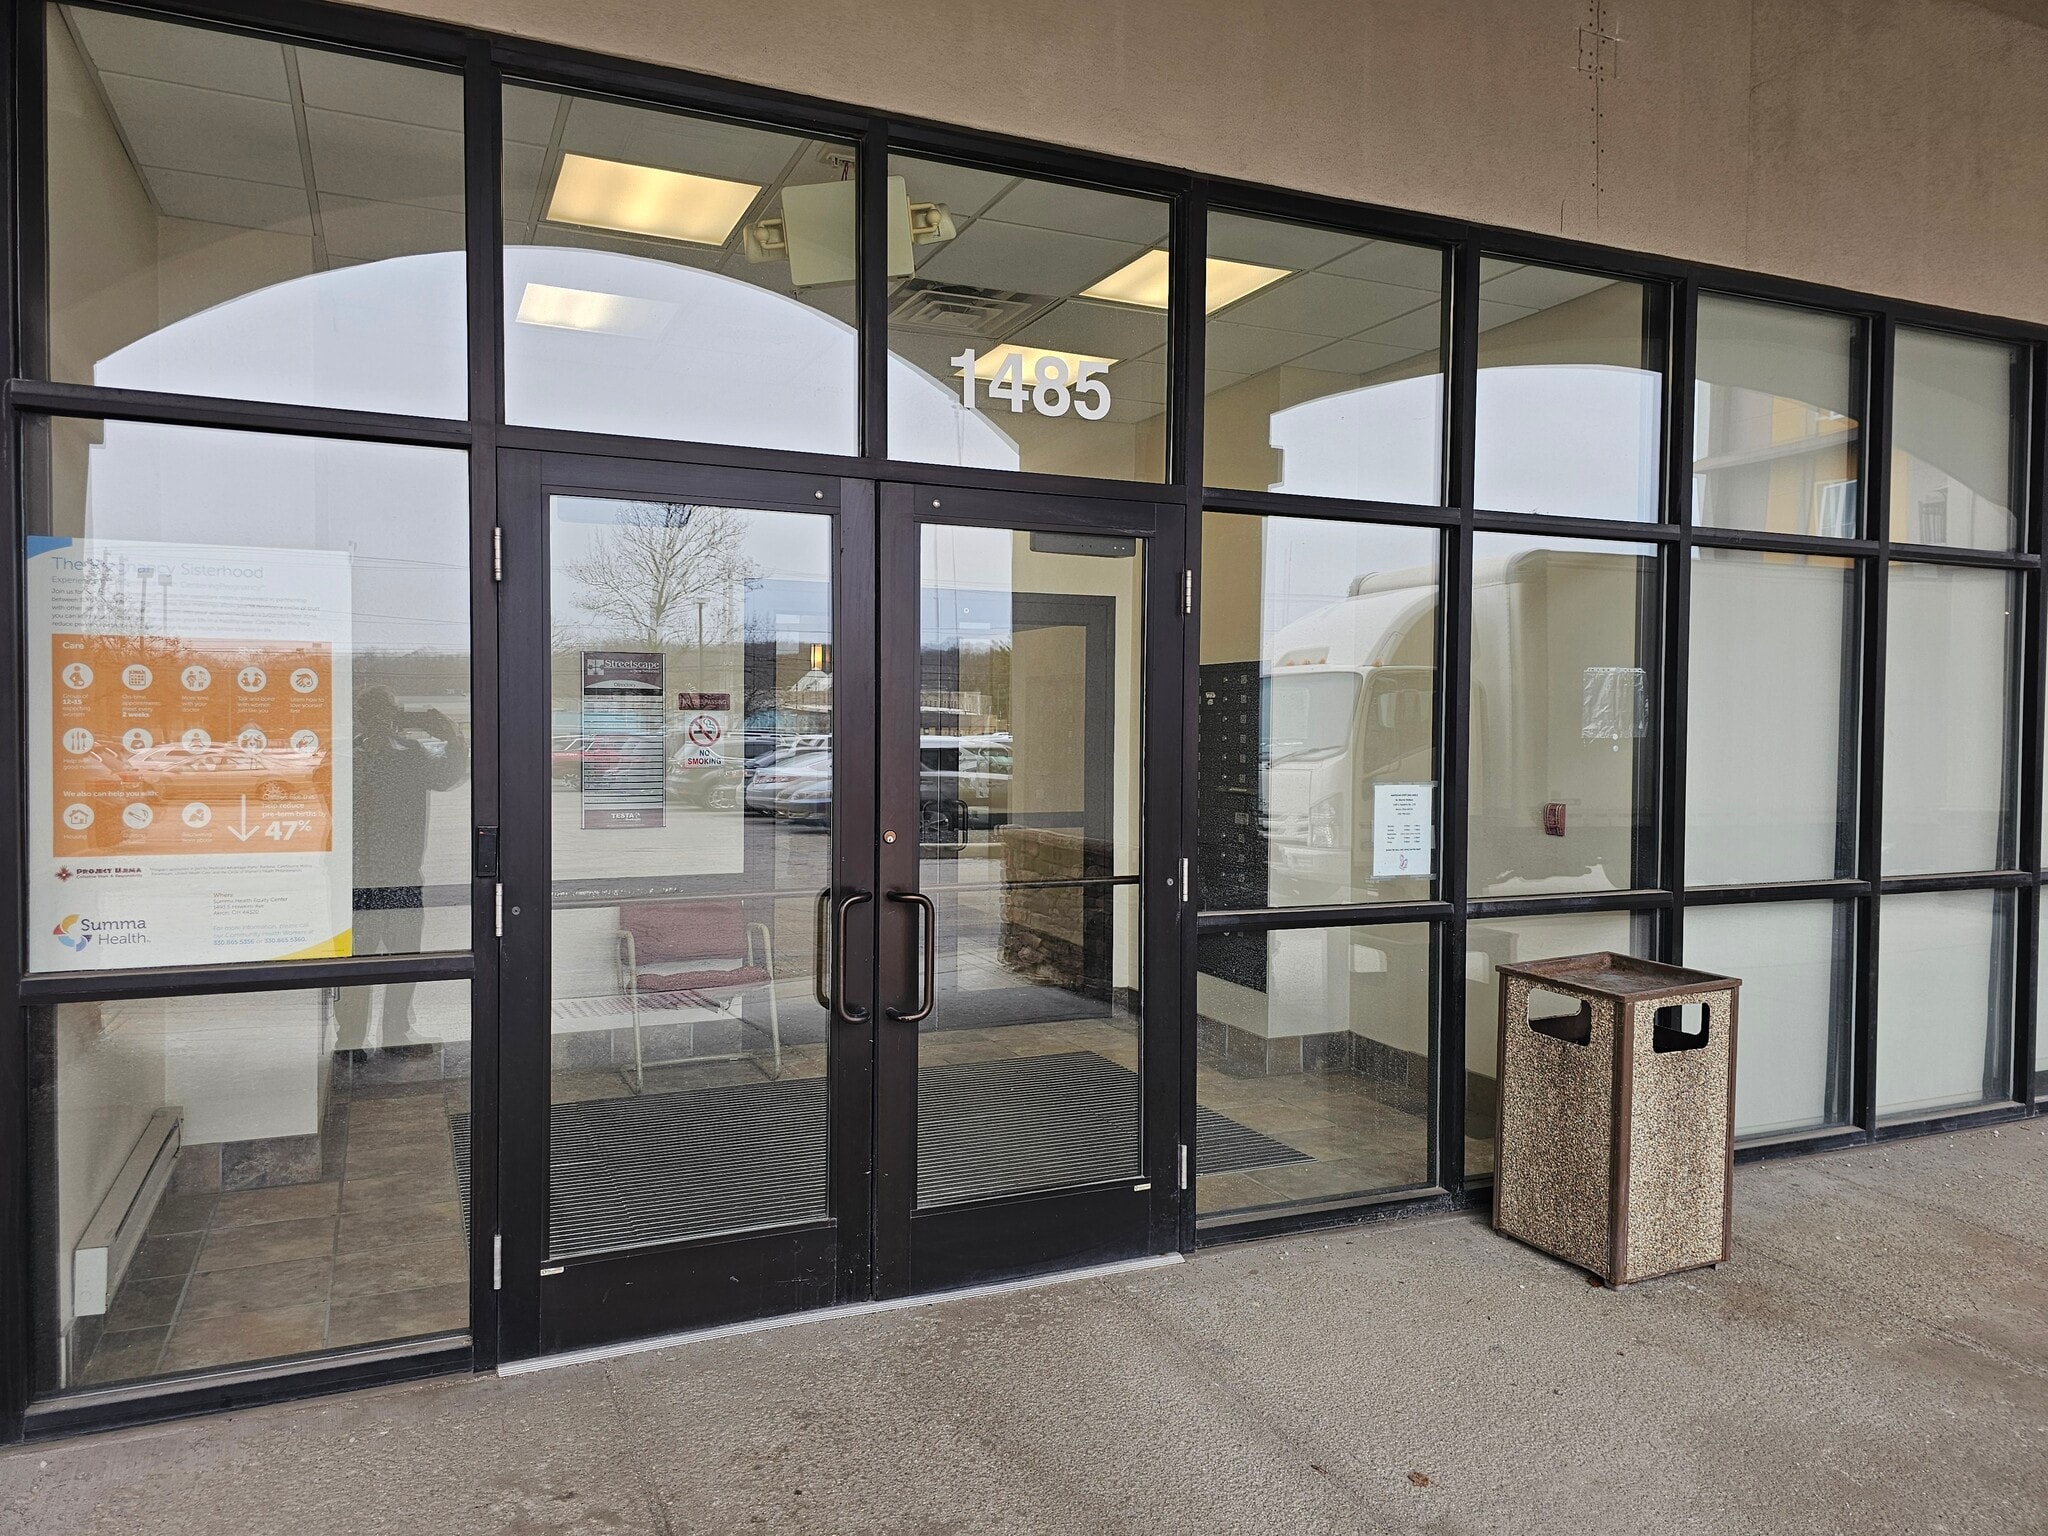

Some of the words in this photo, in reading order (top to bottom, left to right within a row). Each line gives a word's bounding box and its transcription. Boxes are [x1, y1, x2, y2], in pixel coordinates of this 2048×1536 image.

[950, 348, 1111, 421] 1485
[51, 556, 83, 571] The
[181, 563, 264, 578] Sisterhood
[63, 641, 85, 650] Care
[604, 659, 660, 670] Streetscape
[687, 757, 722, 765] SMOKING
[108, 790, 125, 799] help
[126, 791, 140, 799] you
[265, 820, 313, 841] 47%
[81, 918, 147, 931] Summa
[98, 933, 147, 945] Health
